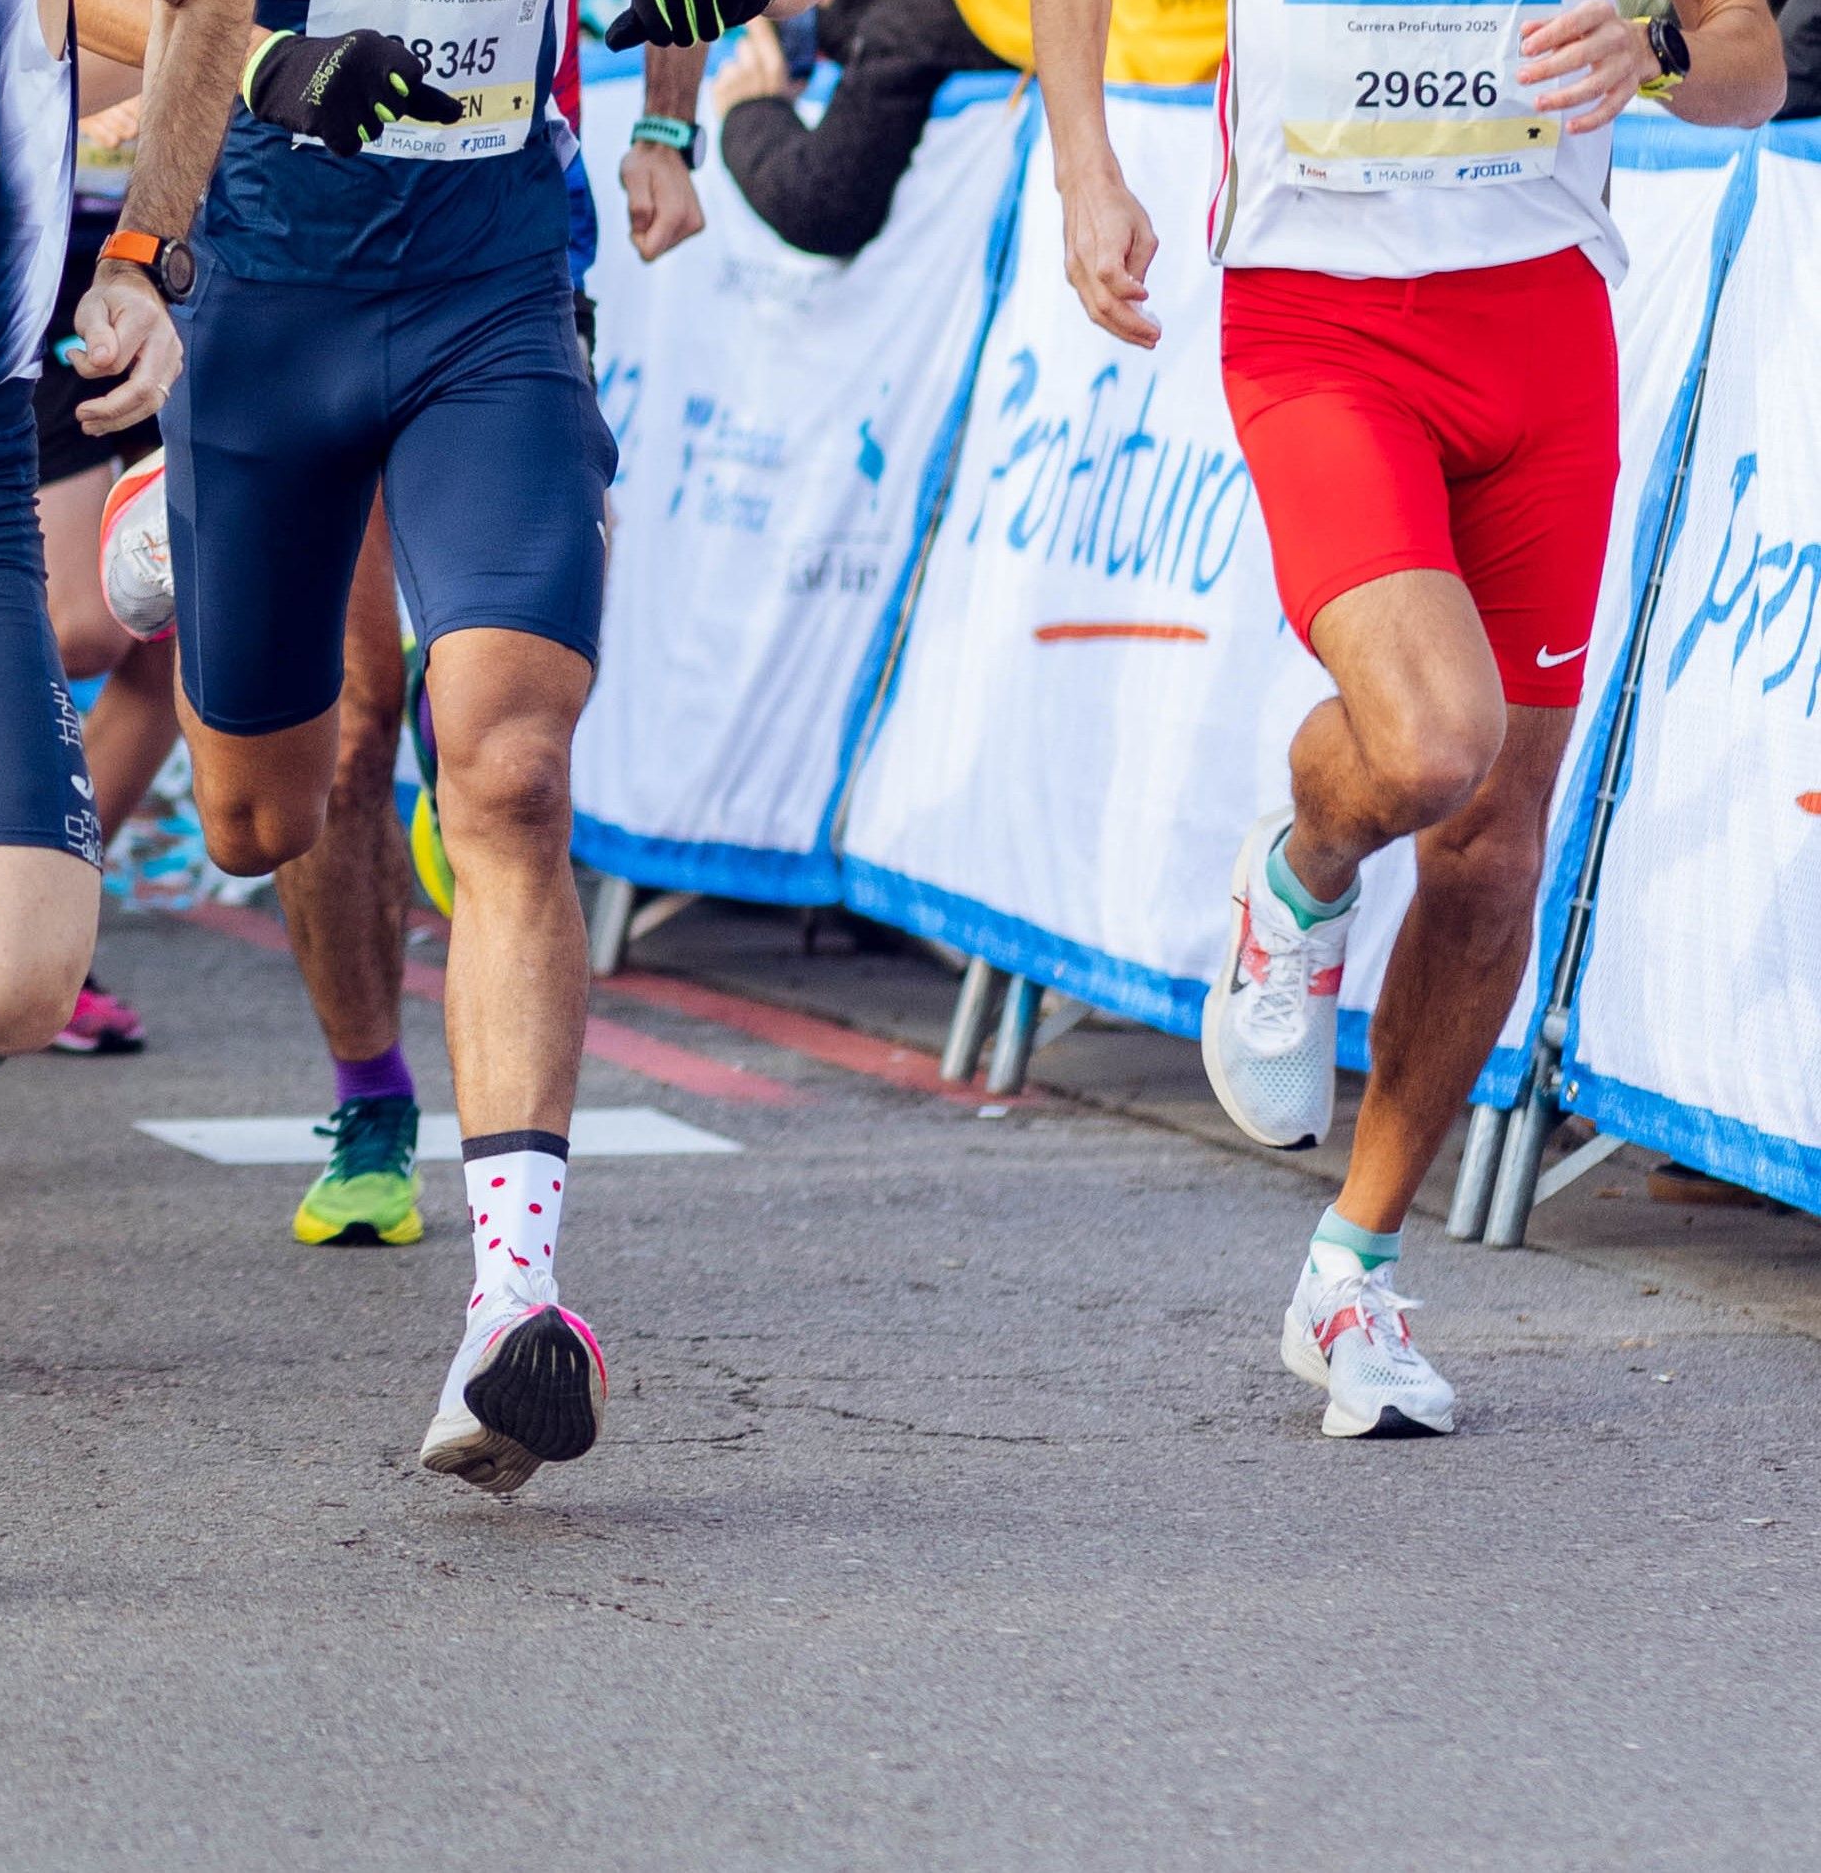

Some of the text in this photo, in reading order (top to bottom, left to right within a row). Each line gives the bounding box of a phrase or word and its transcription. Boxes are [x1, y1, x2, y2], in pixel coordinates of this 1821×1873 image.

[1347, 20, 1498, 33] Carrera ProFuturo 2025
[386, 34, 499, 80] 8345
[1355, 70, 1499, 109] 29626
[391, 138, 446, 154] MADRID
[1378, 168, 1435, 182] MADRID
